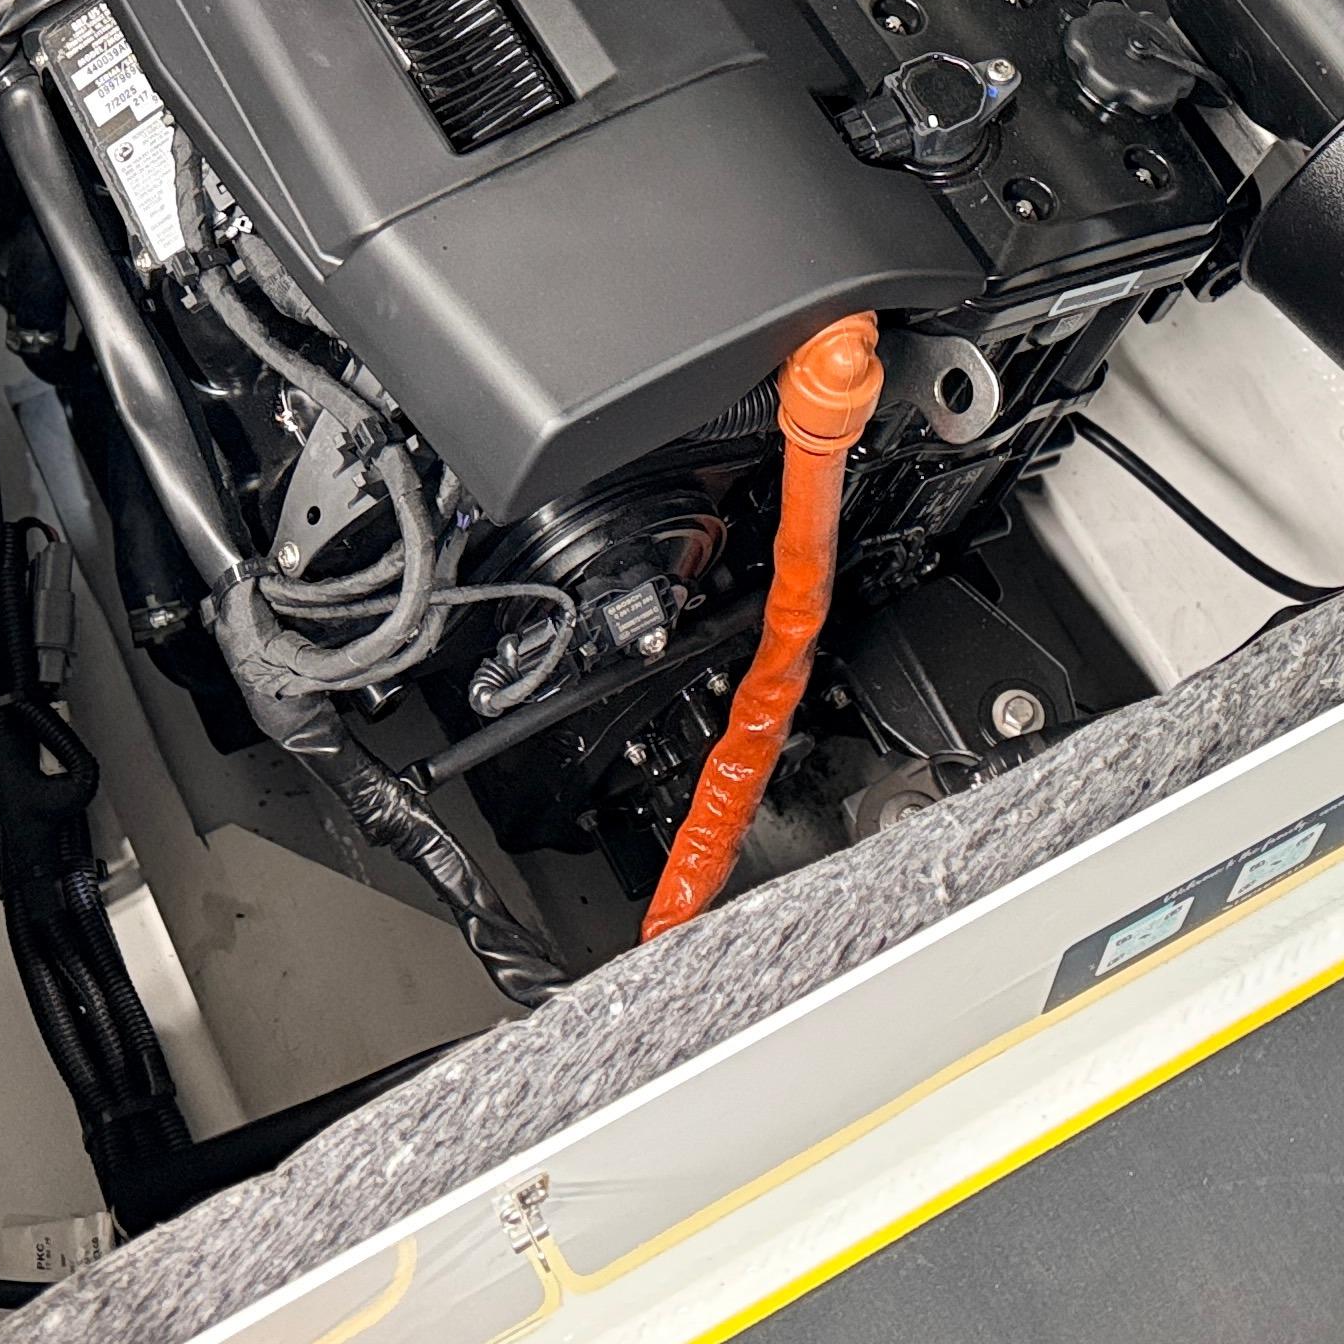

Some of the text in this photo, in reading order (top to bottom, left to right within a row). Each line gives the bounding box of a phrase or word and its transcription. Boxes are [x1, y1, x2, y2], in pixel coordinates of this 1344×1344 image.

[104, 85, 137, 113] 7/2025
[616, 593, 642, 611] BOSCH
[36, 1243, 46, 1271] PKC
